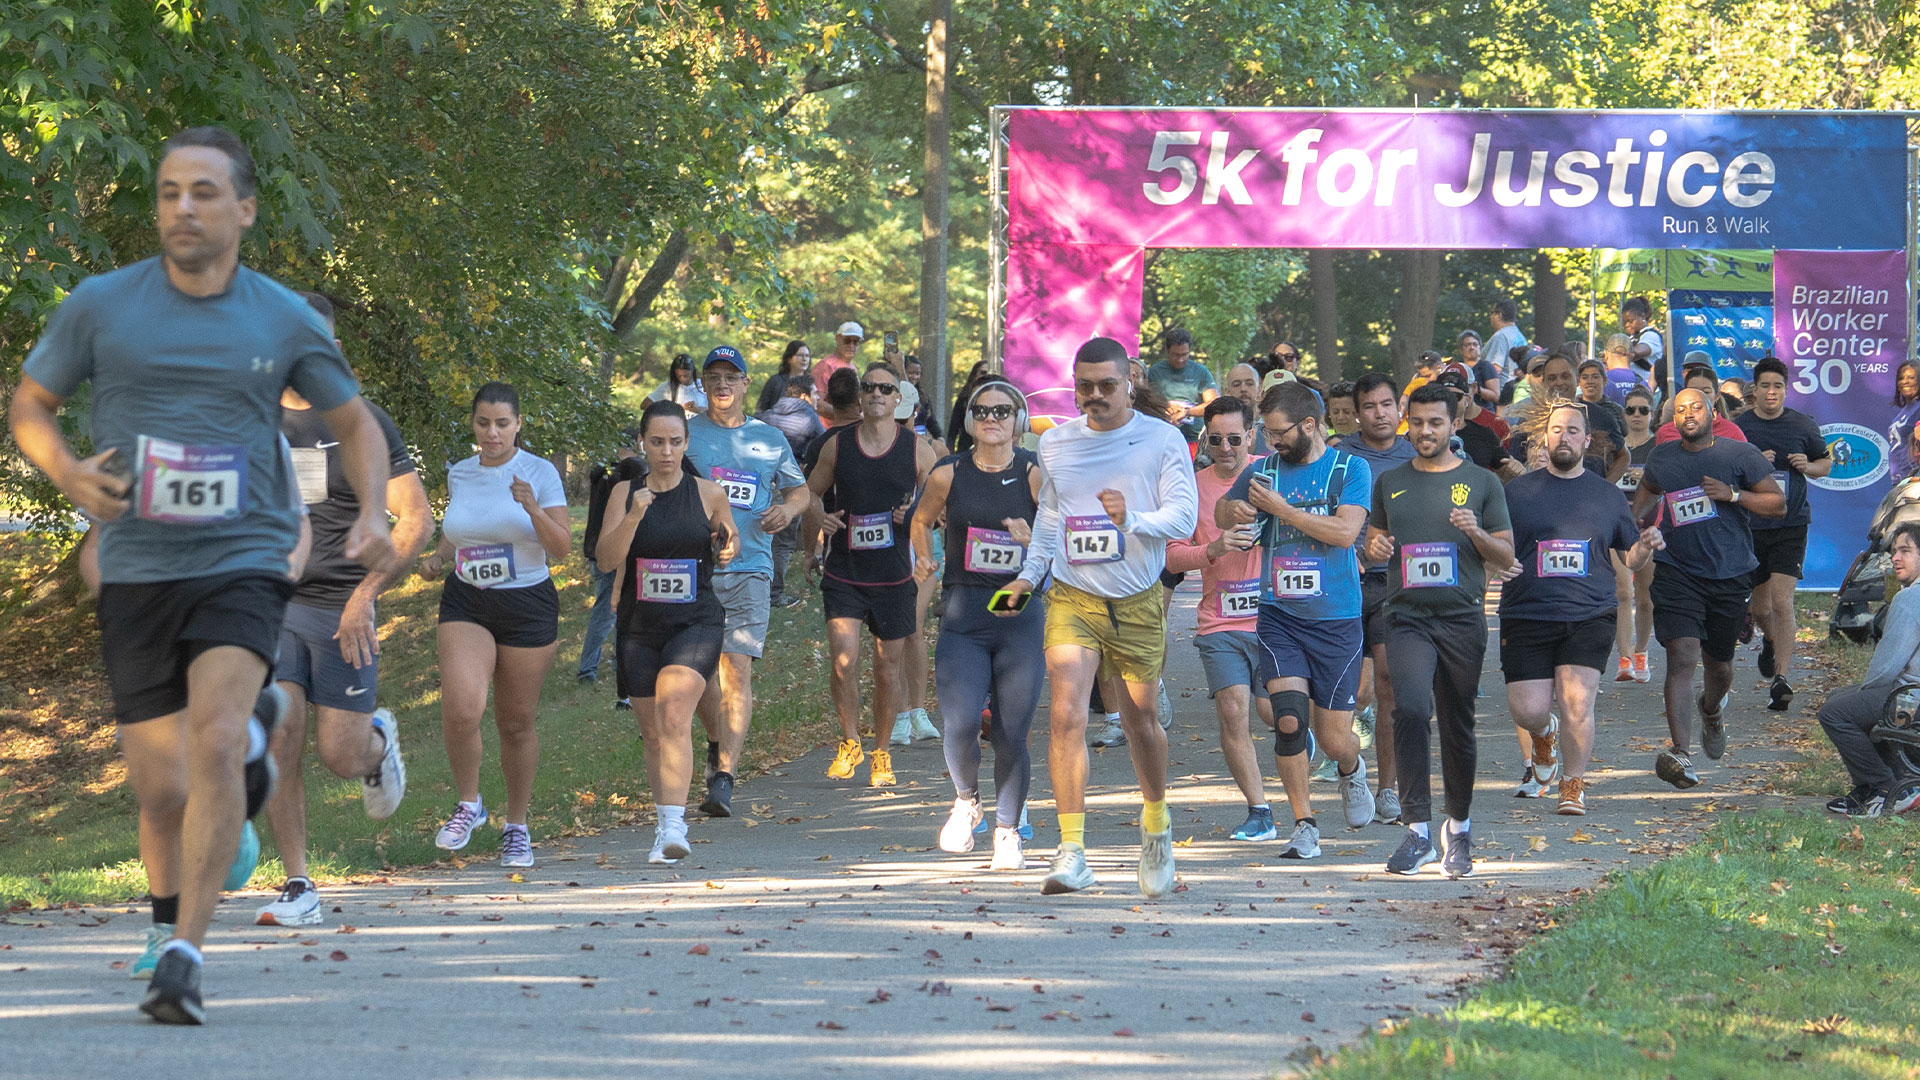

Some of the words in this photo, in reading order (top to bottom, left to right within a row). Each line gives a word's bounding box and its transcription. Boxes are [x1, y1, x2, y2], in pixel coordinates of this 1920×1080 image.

[1142, 130, 1260, 206] 5k
[1282, 128, 1417, 207] for
[1434, 129, 1776, 208] Justice
[1662, 216, 1699, 234] Run
[1705, 216, 1718, 234] &
[1723, 216, 1771, 234] Walk
[1791, 285, 1889, 306] Brazilian
[1791, 309, 1889, 332] Worker
[1792, 332, 1889, 356] Center
[1792, 359, 1852, 395] 30
[1853, 363, 1889, 374] YEARS
[168, 480, 224, 506] 161
[1679, 500, 1705, 517] 117
[856, 528, 885, 543] 103
[1072, 535, 1109, 553] 147
[980, 548, 1014, 565] 127
[1549, 555, 1578, 569] 114
[468, 563, 503, 581] 168
[1418, 562, 1441, 577] 10
[649, 578, 684, 594] 132
[1283, 575, 1314, 590] 115
[1228, 595, 1259, 611] 125
